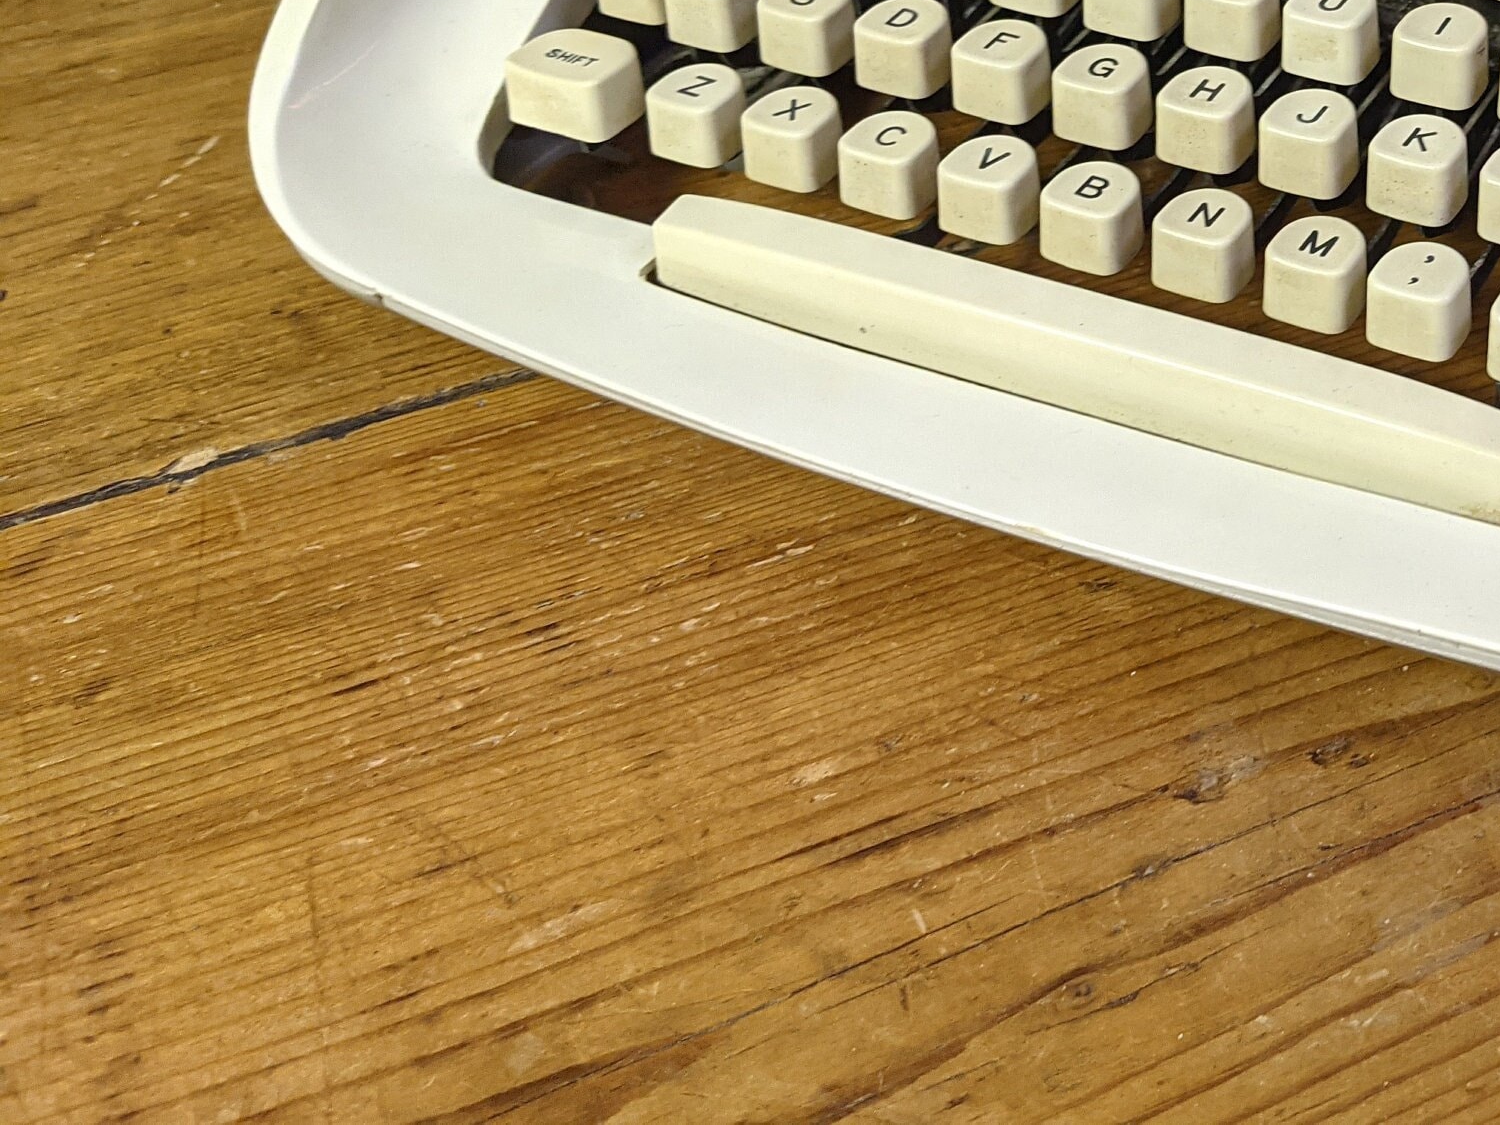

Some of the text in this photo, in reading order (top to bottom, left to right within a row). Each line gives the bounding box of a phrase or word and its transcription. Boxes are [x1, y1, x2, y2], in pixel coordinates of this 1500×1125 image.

[884, 7, 919, 28] D
[1434, 16, 1452, 36] I
[983, 31, 1020, 50] F
[545, 48, 599, 66] SHIFT
[1088, 57, 1119, 78] G
[676, 75, 717, 98] Z
[1188, 78, 1226, 102] H
[772, 98, 812, 121] X
[1296, 105, 1329, 124] J
[875, 126, 907, 146] C
[1402, 127, 1438, 152] K
[978, 147, 1011, 170] V
[1074, 175, 1110, 199] B
[1187, 202, 1226, 228] N
[1298, 229, 1340, 258] M
